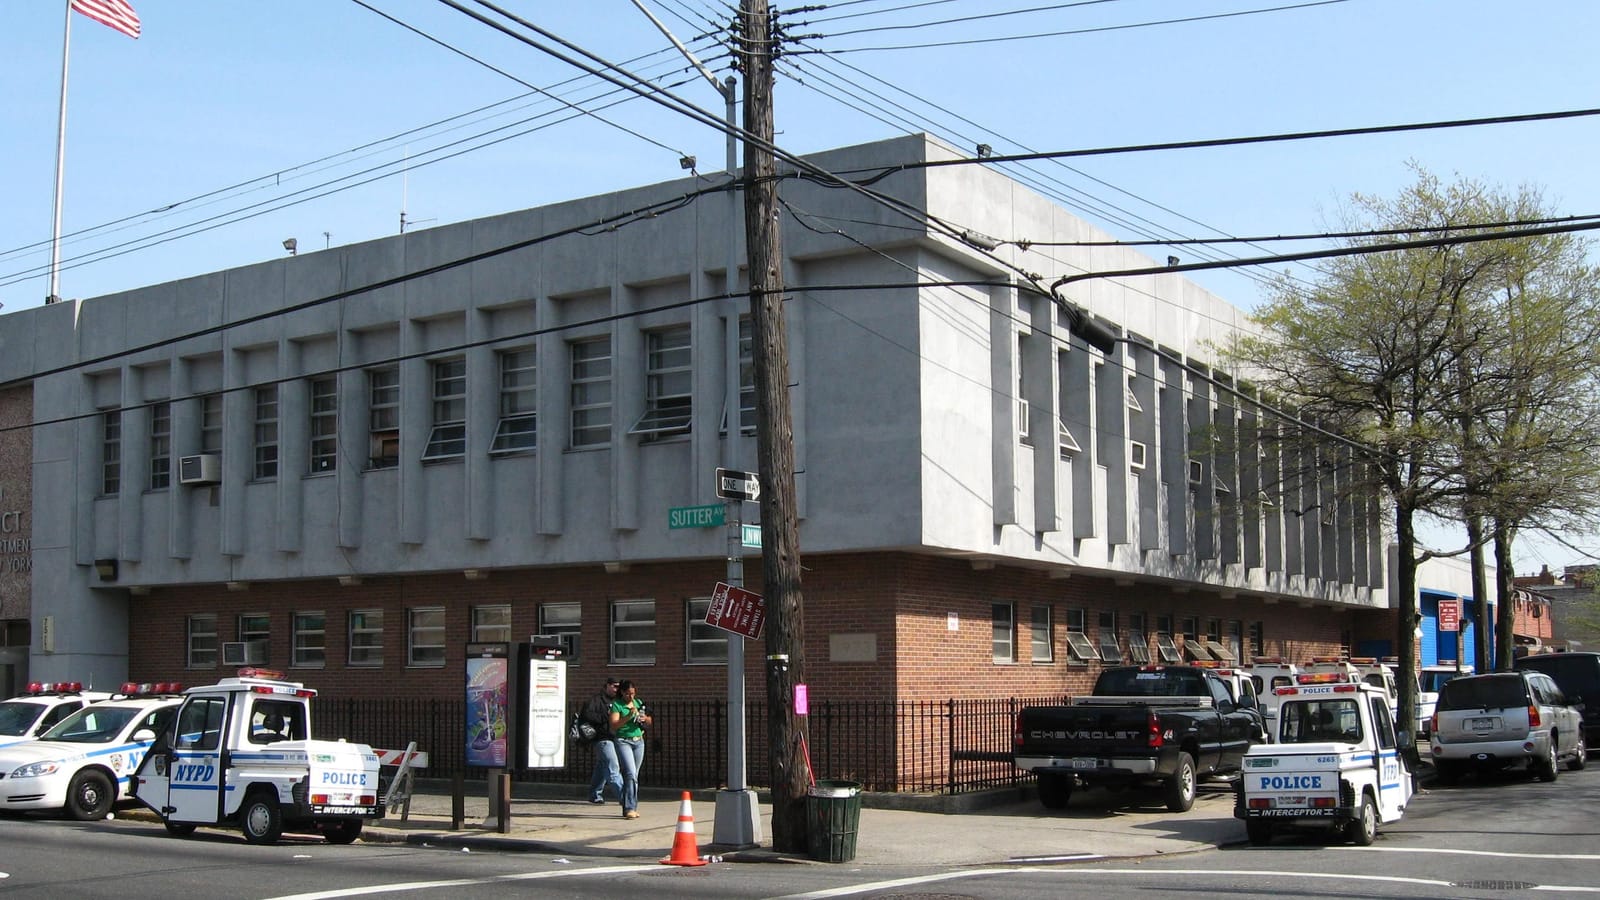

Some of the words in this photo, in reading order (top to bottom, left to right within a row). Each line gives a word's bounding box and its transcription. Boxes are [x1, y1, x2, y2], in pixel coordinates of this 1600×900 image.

[723, 479, 736, 490] ONE
[746, 481, 760, 491] WAY
[671, 508, 713, 527] SUTTER
[0, 538, 32, 553] TMEN
[748, 608, 761, 636] STANDING
[1030, 731, 1139, 739] CHEVROLET
[174, 764, 214, 782] NYPD
[322, 772, 367, 785] POLICE
[1260, 776, 1322, 789] POLICE
[323, 806, 367, 814] INTERCEPTOR
